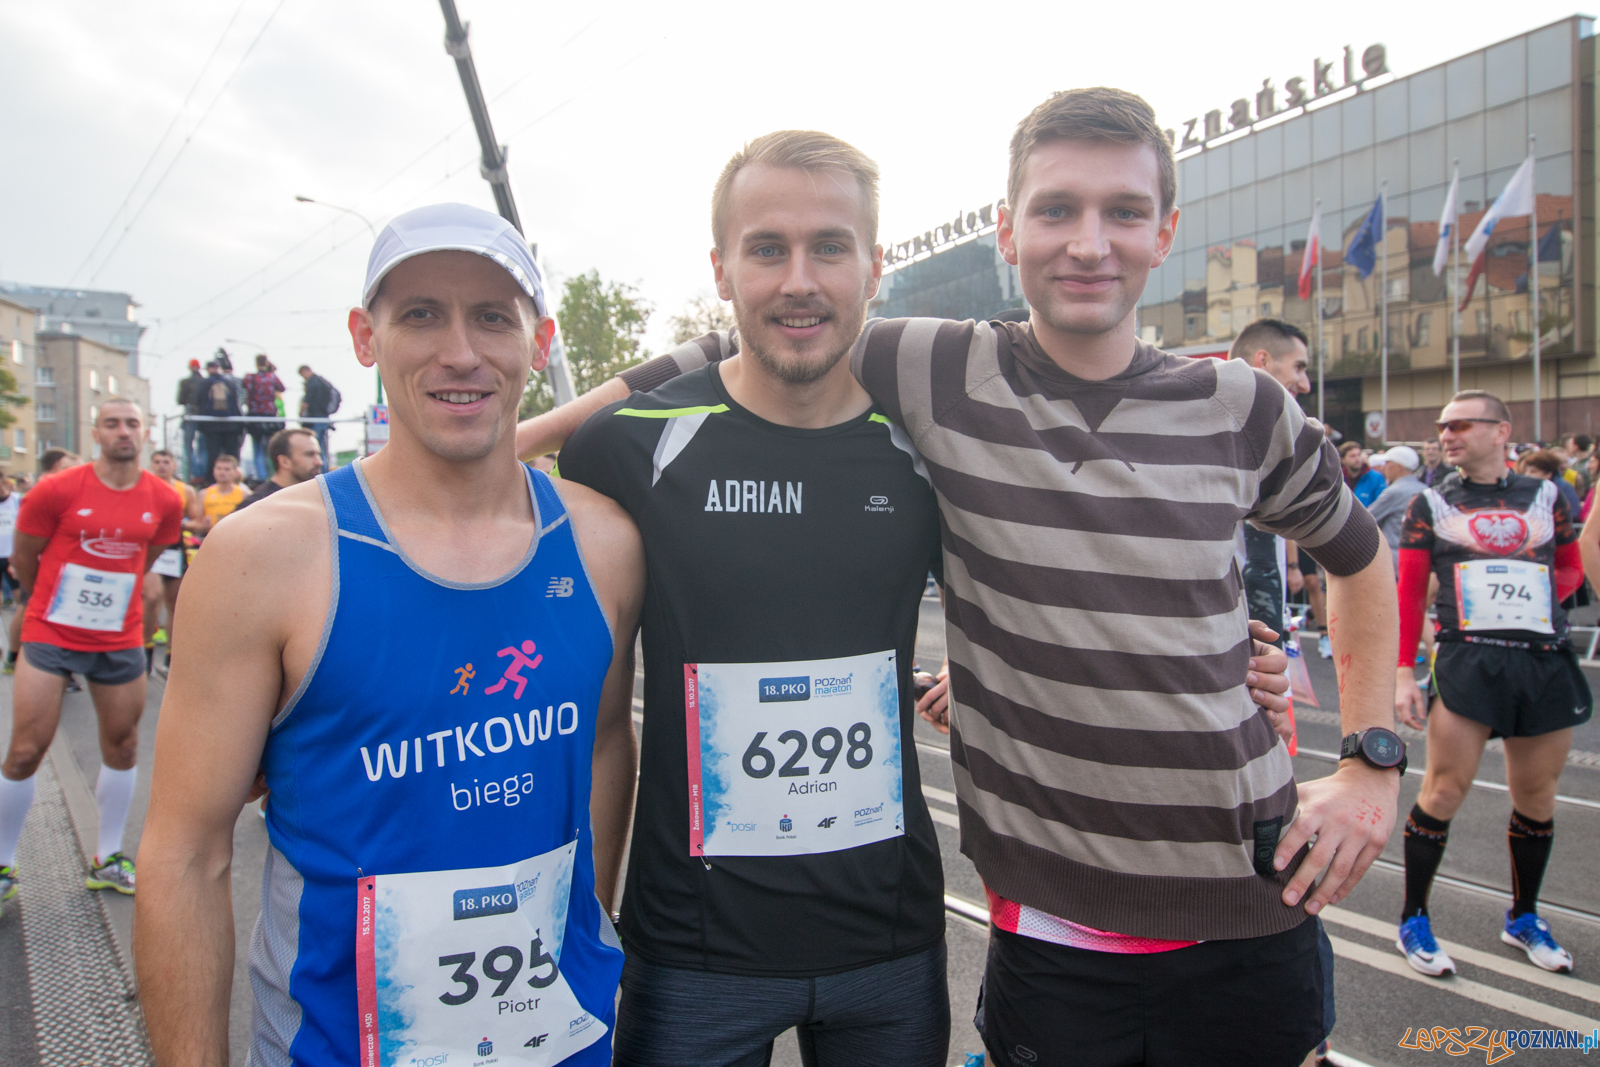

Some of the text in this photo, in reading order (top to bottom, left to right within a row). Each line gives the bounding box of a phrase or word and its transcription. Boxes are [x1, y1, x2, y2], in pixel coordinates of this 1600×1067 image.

[704, 479, 803, 514] ADRIAN
[864, 505, 895, 514] Kalenji
[77, 589, 113, 608] 536
[1487, 583, 1533, 602] 794
[764, 685, 779, 696] 18.
[781, 683, 806, 695] PKO
[815, 684, 852, 695] maraton
[360, 701, 579, 782] WITKOWO
[742, 722, 873, 779] 6298
[450, 772, 534, 811] biega
[787, 780, 838, 796] Adrian
[459, 897, 479, 912] 18.
[481, 893, 513, 909] PKO
[362, 896, 371, 936] 15.10.2017
[438, 929, 559, 1006] 395
[498, 997, 541, 1015] Piotr
[365, 1013, 373, 1028] M30
